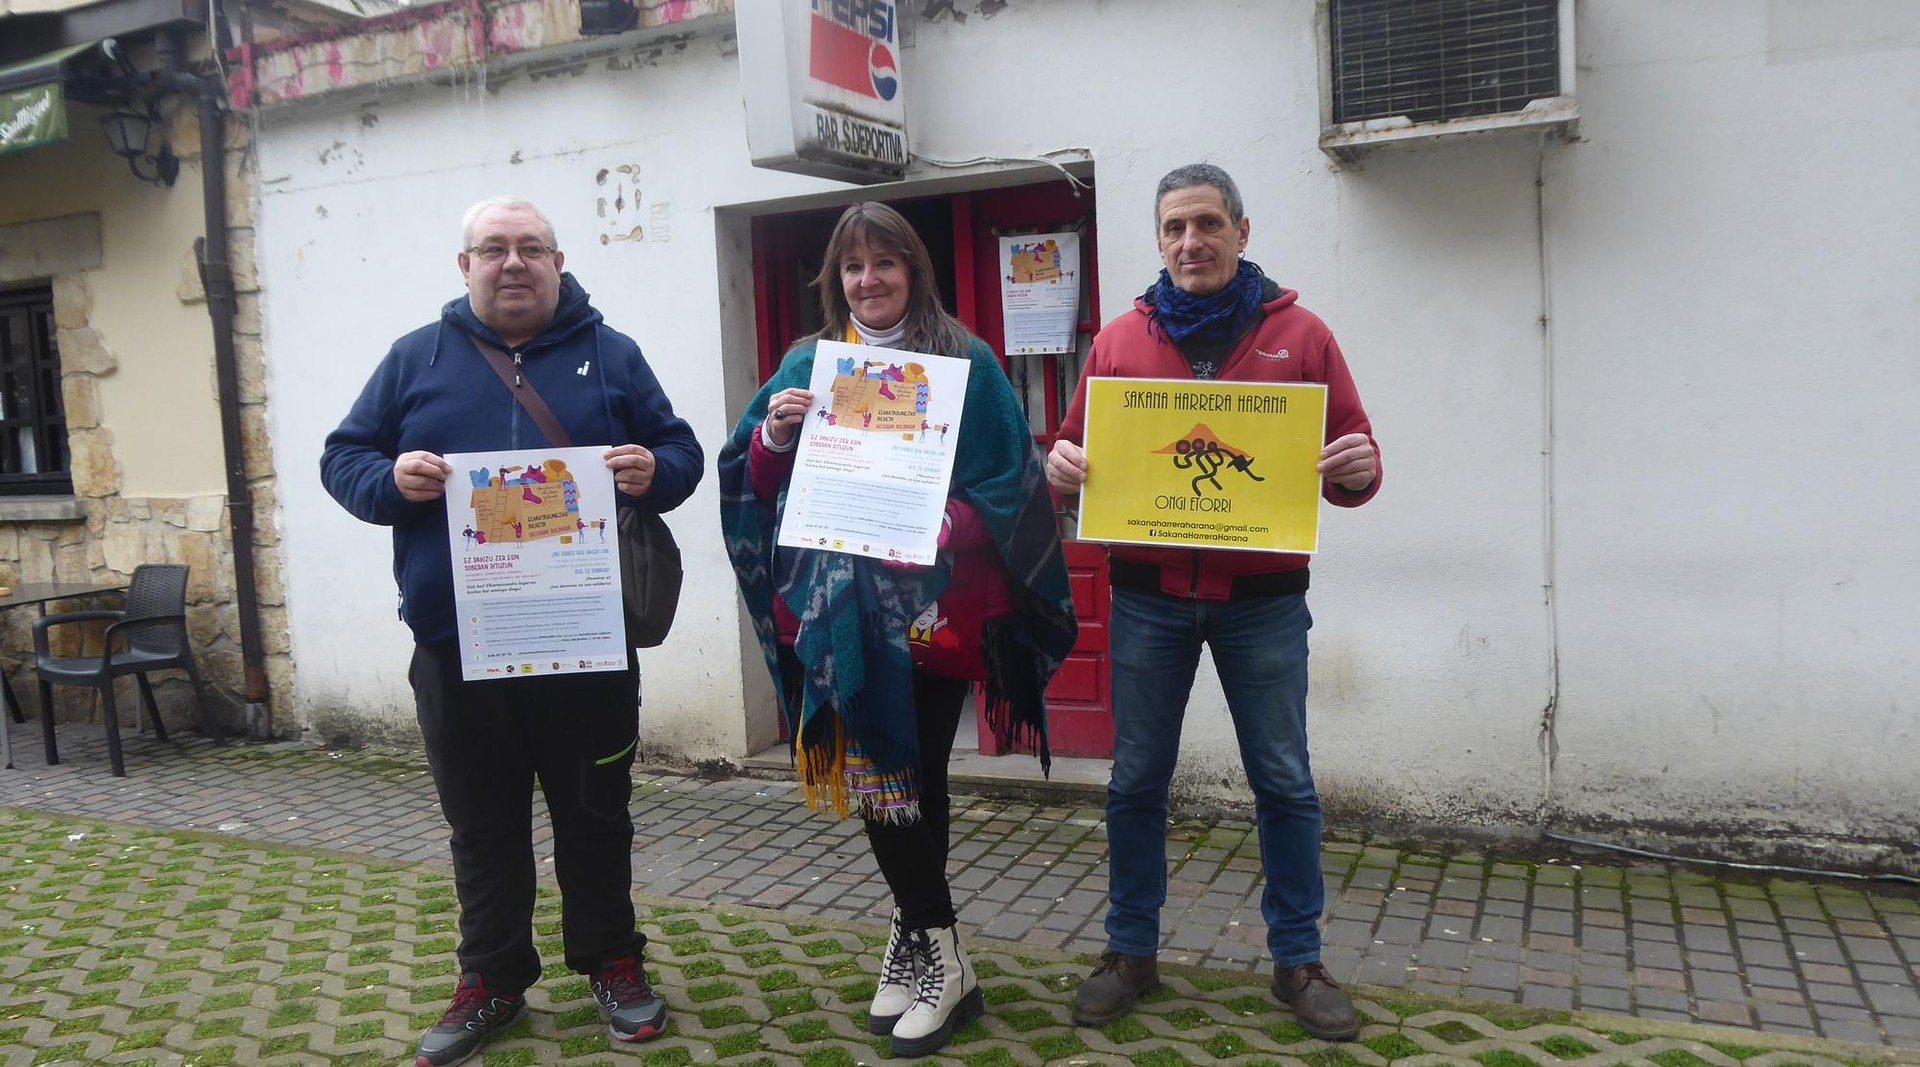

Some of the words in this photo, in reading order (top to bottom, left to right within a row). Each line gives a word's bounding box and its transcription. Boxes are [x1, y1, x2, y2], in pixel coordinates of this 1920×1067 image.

[812, 0, 894, 43] EPSI
[816, 114, 840, 150] BAR
[843, 121, 904, 164] S.DEPORTIVA
[1123, 390, 1168, 410] SAKANA
[1174, 392, 1232, 412] HARRERA
[1238, 395, 1287, 414] HARANA
[1154, 495, 1186, 511] ONGI
[1190, 497, 1231, 513] ETORRI
[1158, 530, 1248, 542] SakanaHarreraHarana
